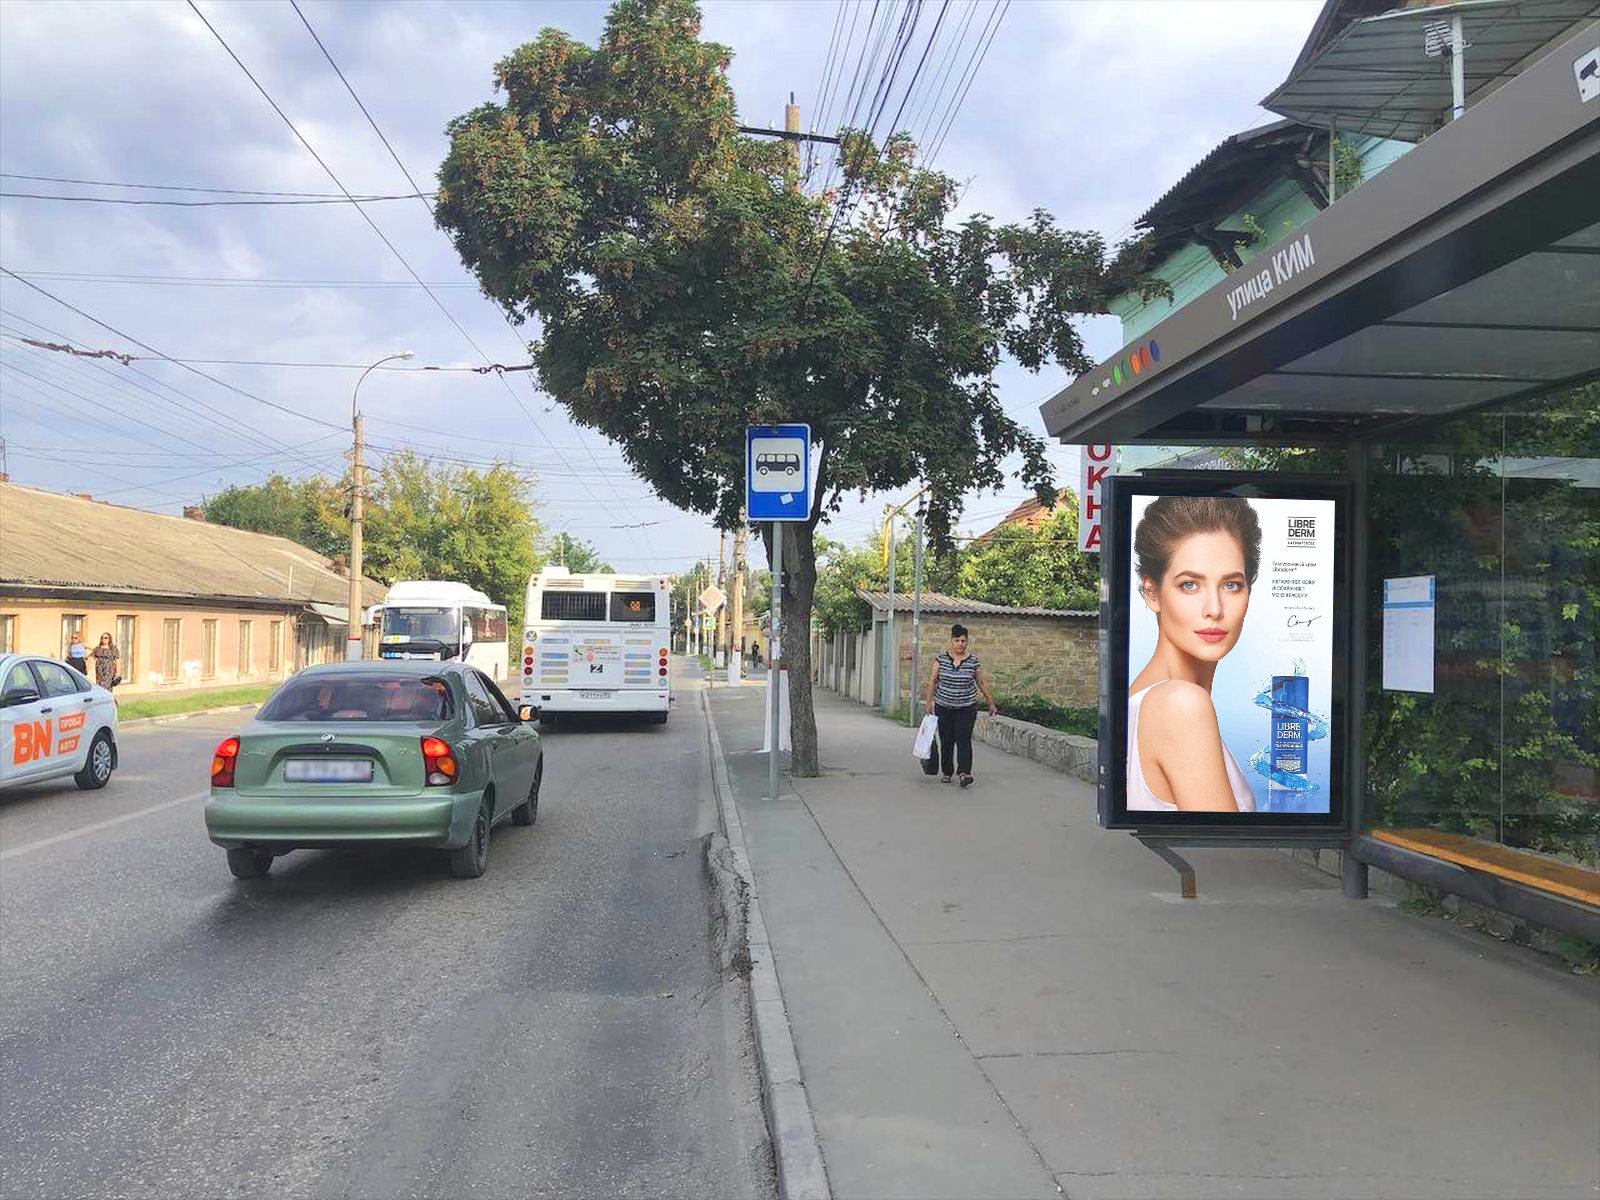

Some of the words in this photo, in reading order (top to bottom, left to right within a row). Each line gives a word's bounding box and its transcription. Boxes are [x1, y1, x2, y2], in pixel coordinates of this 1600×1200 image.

[1227, 269, 1273, 320] улица
[1272, 234, 1315, 285] КИМ
[1288, 519, 1315, 528] LIBRE
[1288, 528, 1315, 538] DERM
[1277, 722, 1301, 731] LIBRE
[1277, 731, 1301, 739] DERM
[14, 719, 52, 766] BN
